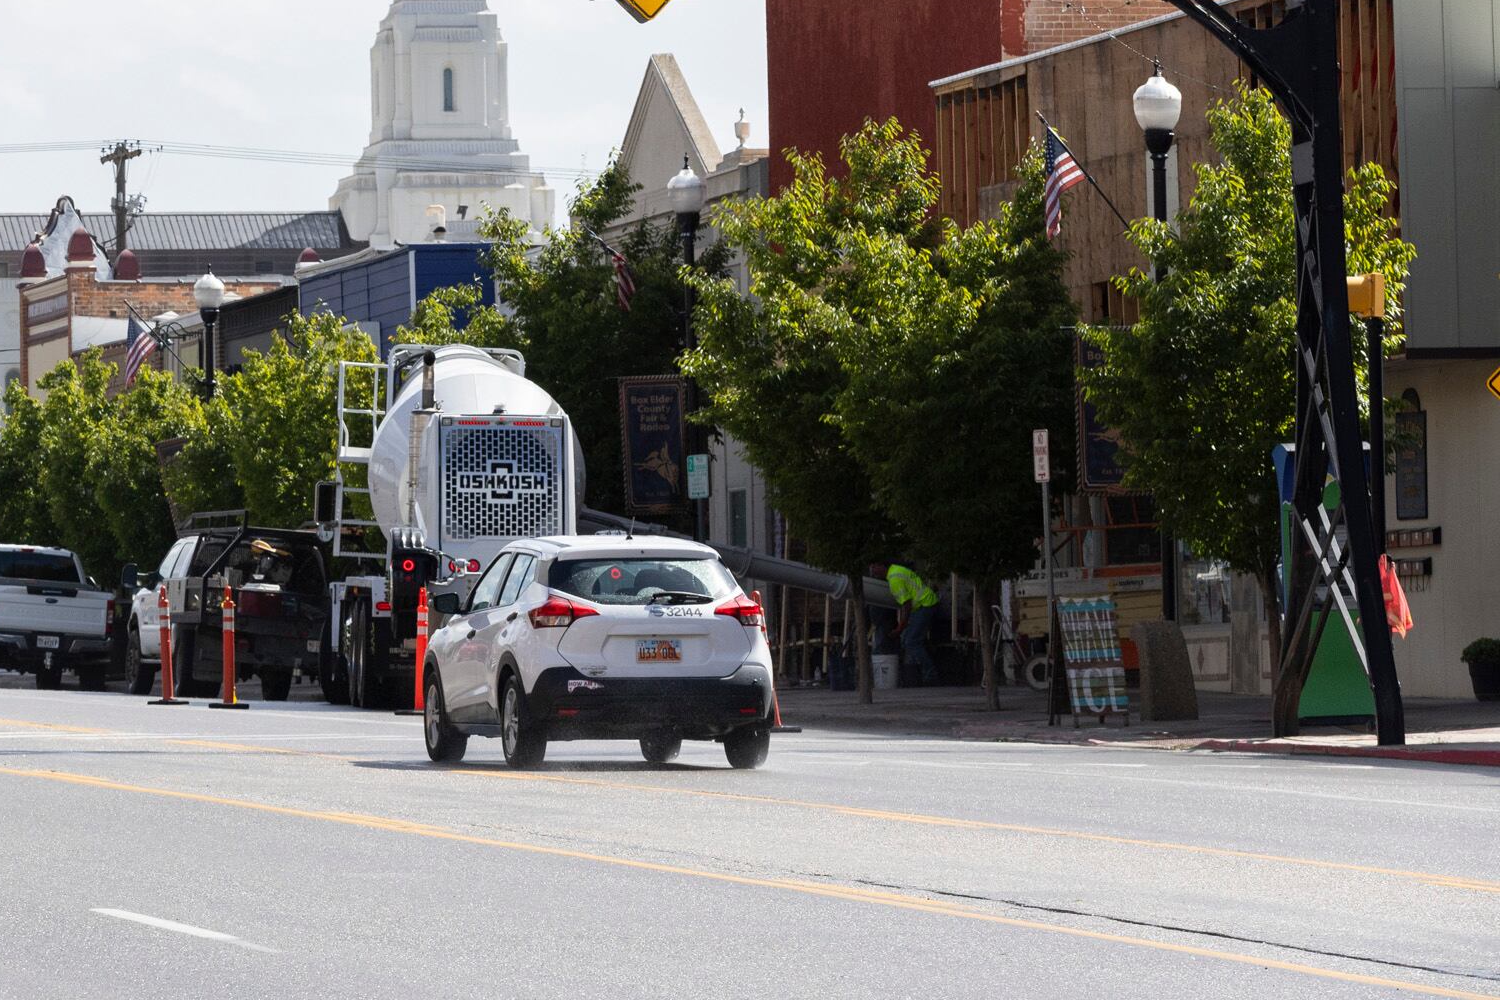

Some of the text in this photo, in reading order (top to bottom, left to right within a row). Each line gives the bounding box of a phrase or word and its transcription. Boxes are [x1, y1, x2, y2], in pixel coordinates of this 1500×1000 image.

[637, 404, 671, 415] County
[459, 474, 545, 490] OSHKOSH
[666, 606, 703, 618] 32144
[1067, 667, 1128, 713] ICE
